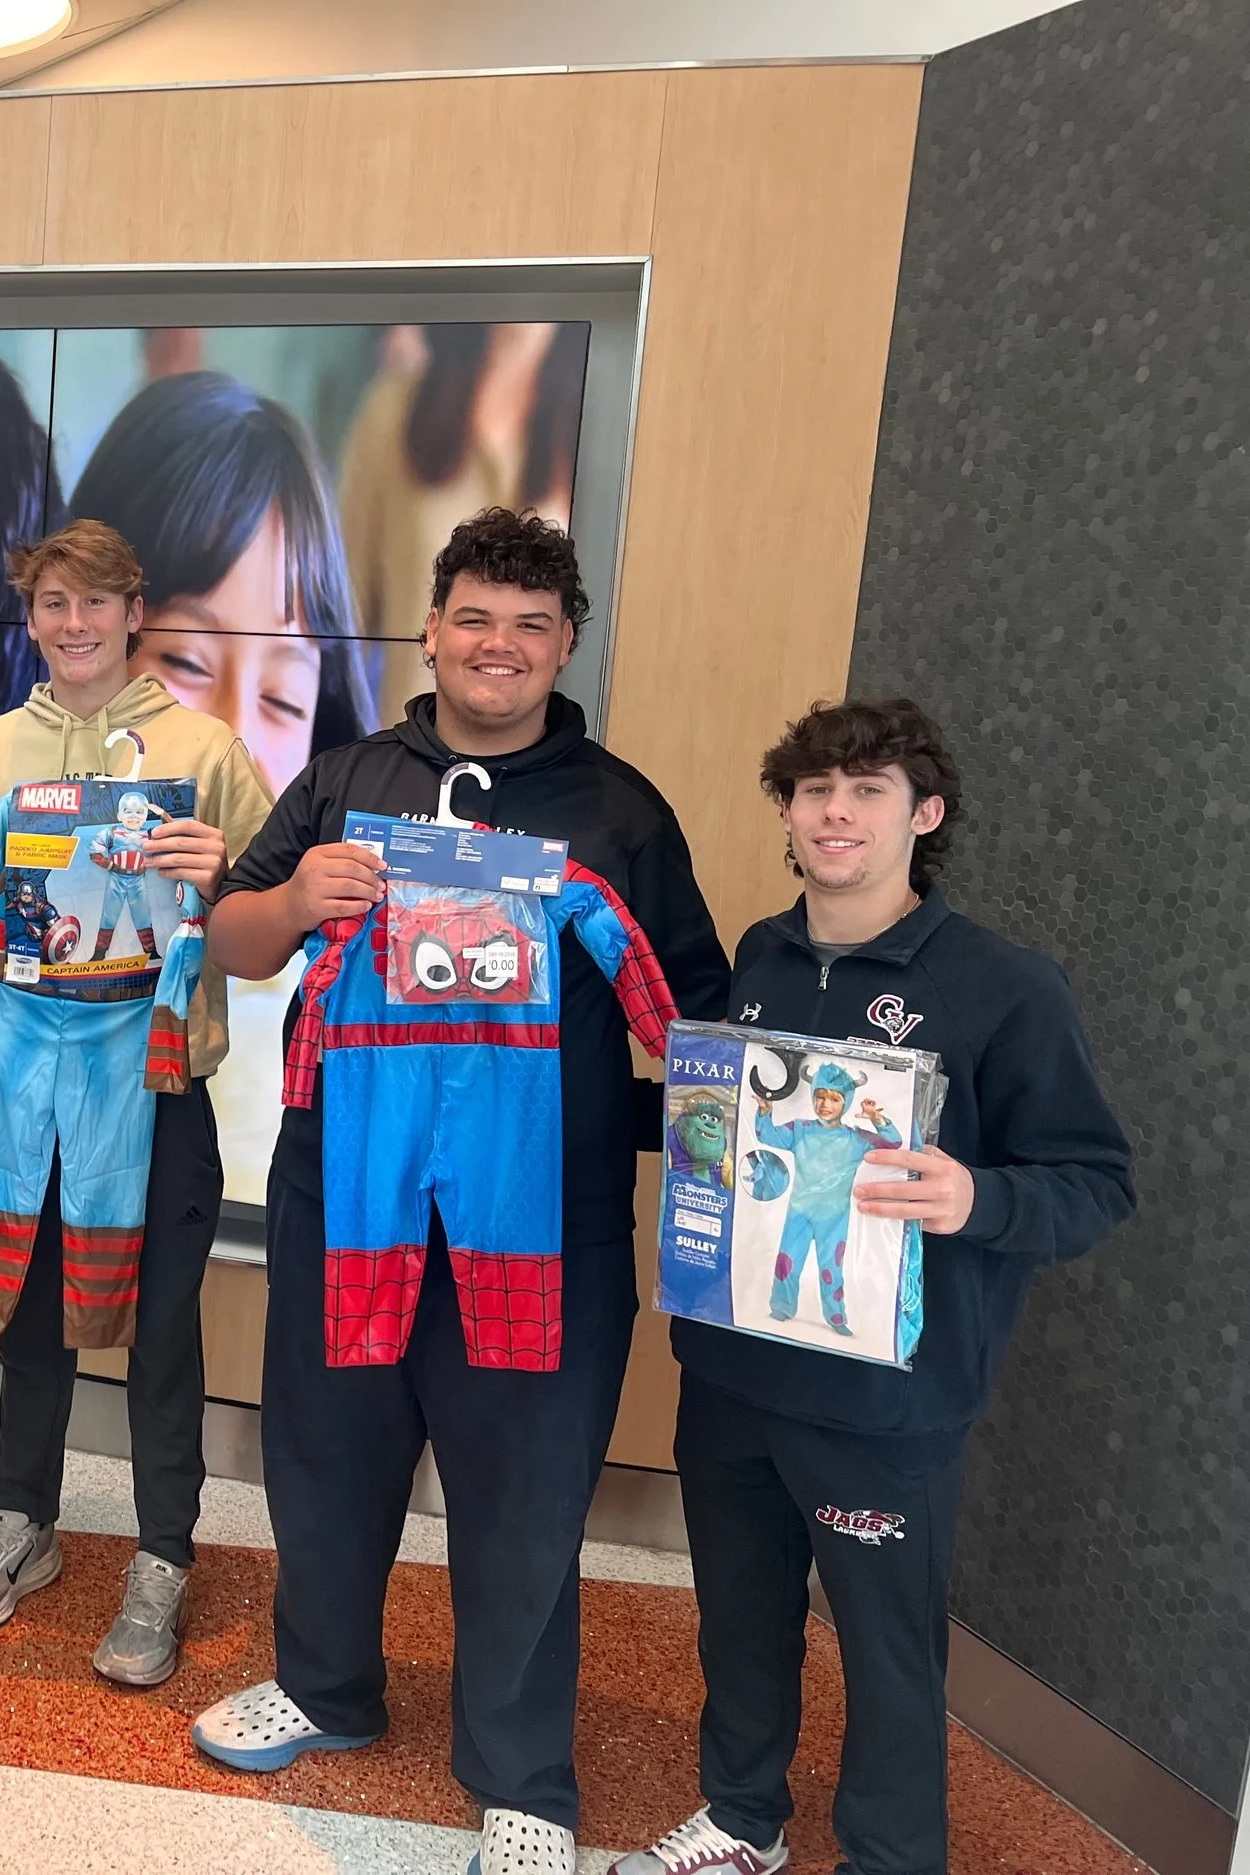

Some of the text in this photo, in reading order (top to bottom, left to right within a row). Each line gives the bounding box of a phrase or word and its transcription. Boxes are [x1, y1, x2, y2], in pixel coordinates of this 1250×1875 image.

[21, 787, 79, 810] MARVEL
[46, 961, 140, 975] CAPTAIN AMERICA
[672, 1058, 735, 1080] PIXAR
[673, 1184, 728, 1206] MONSTERS
[676, 1196, 723, 1213] UNIVERSITY
[675, 1235, 717, 1254] SULLEY
[816, 1505, 885, 1533] JAGS
